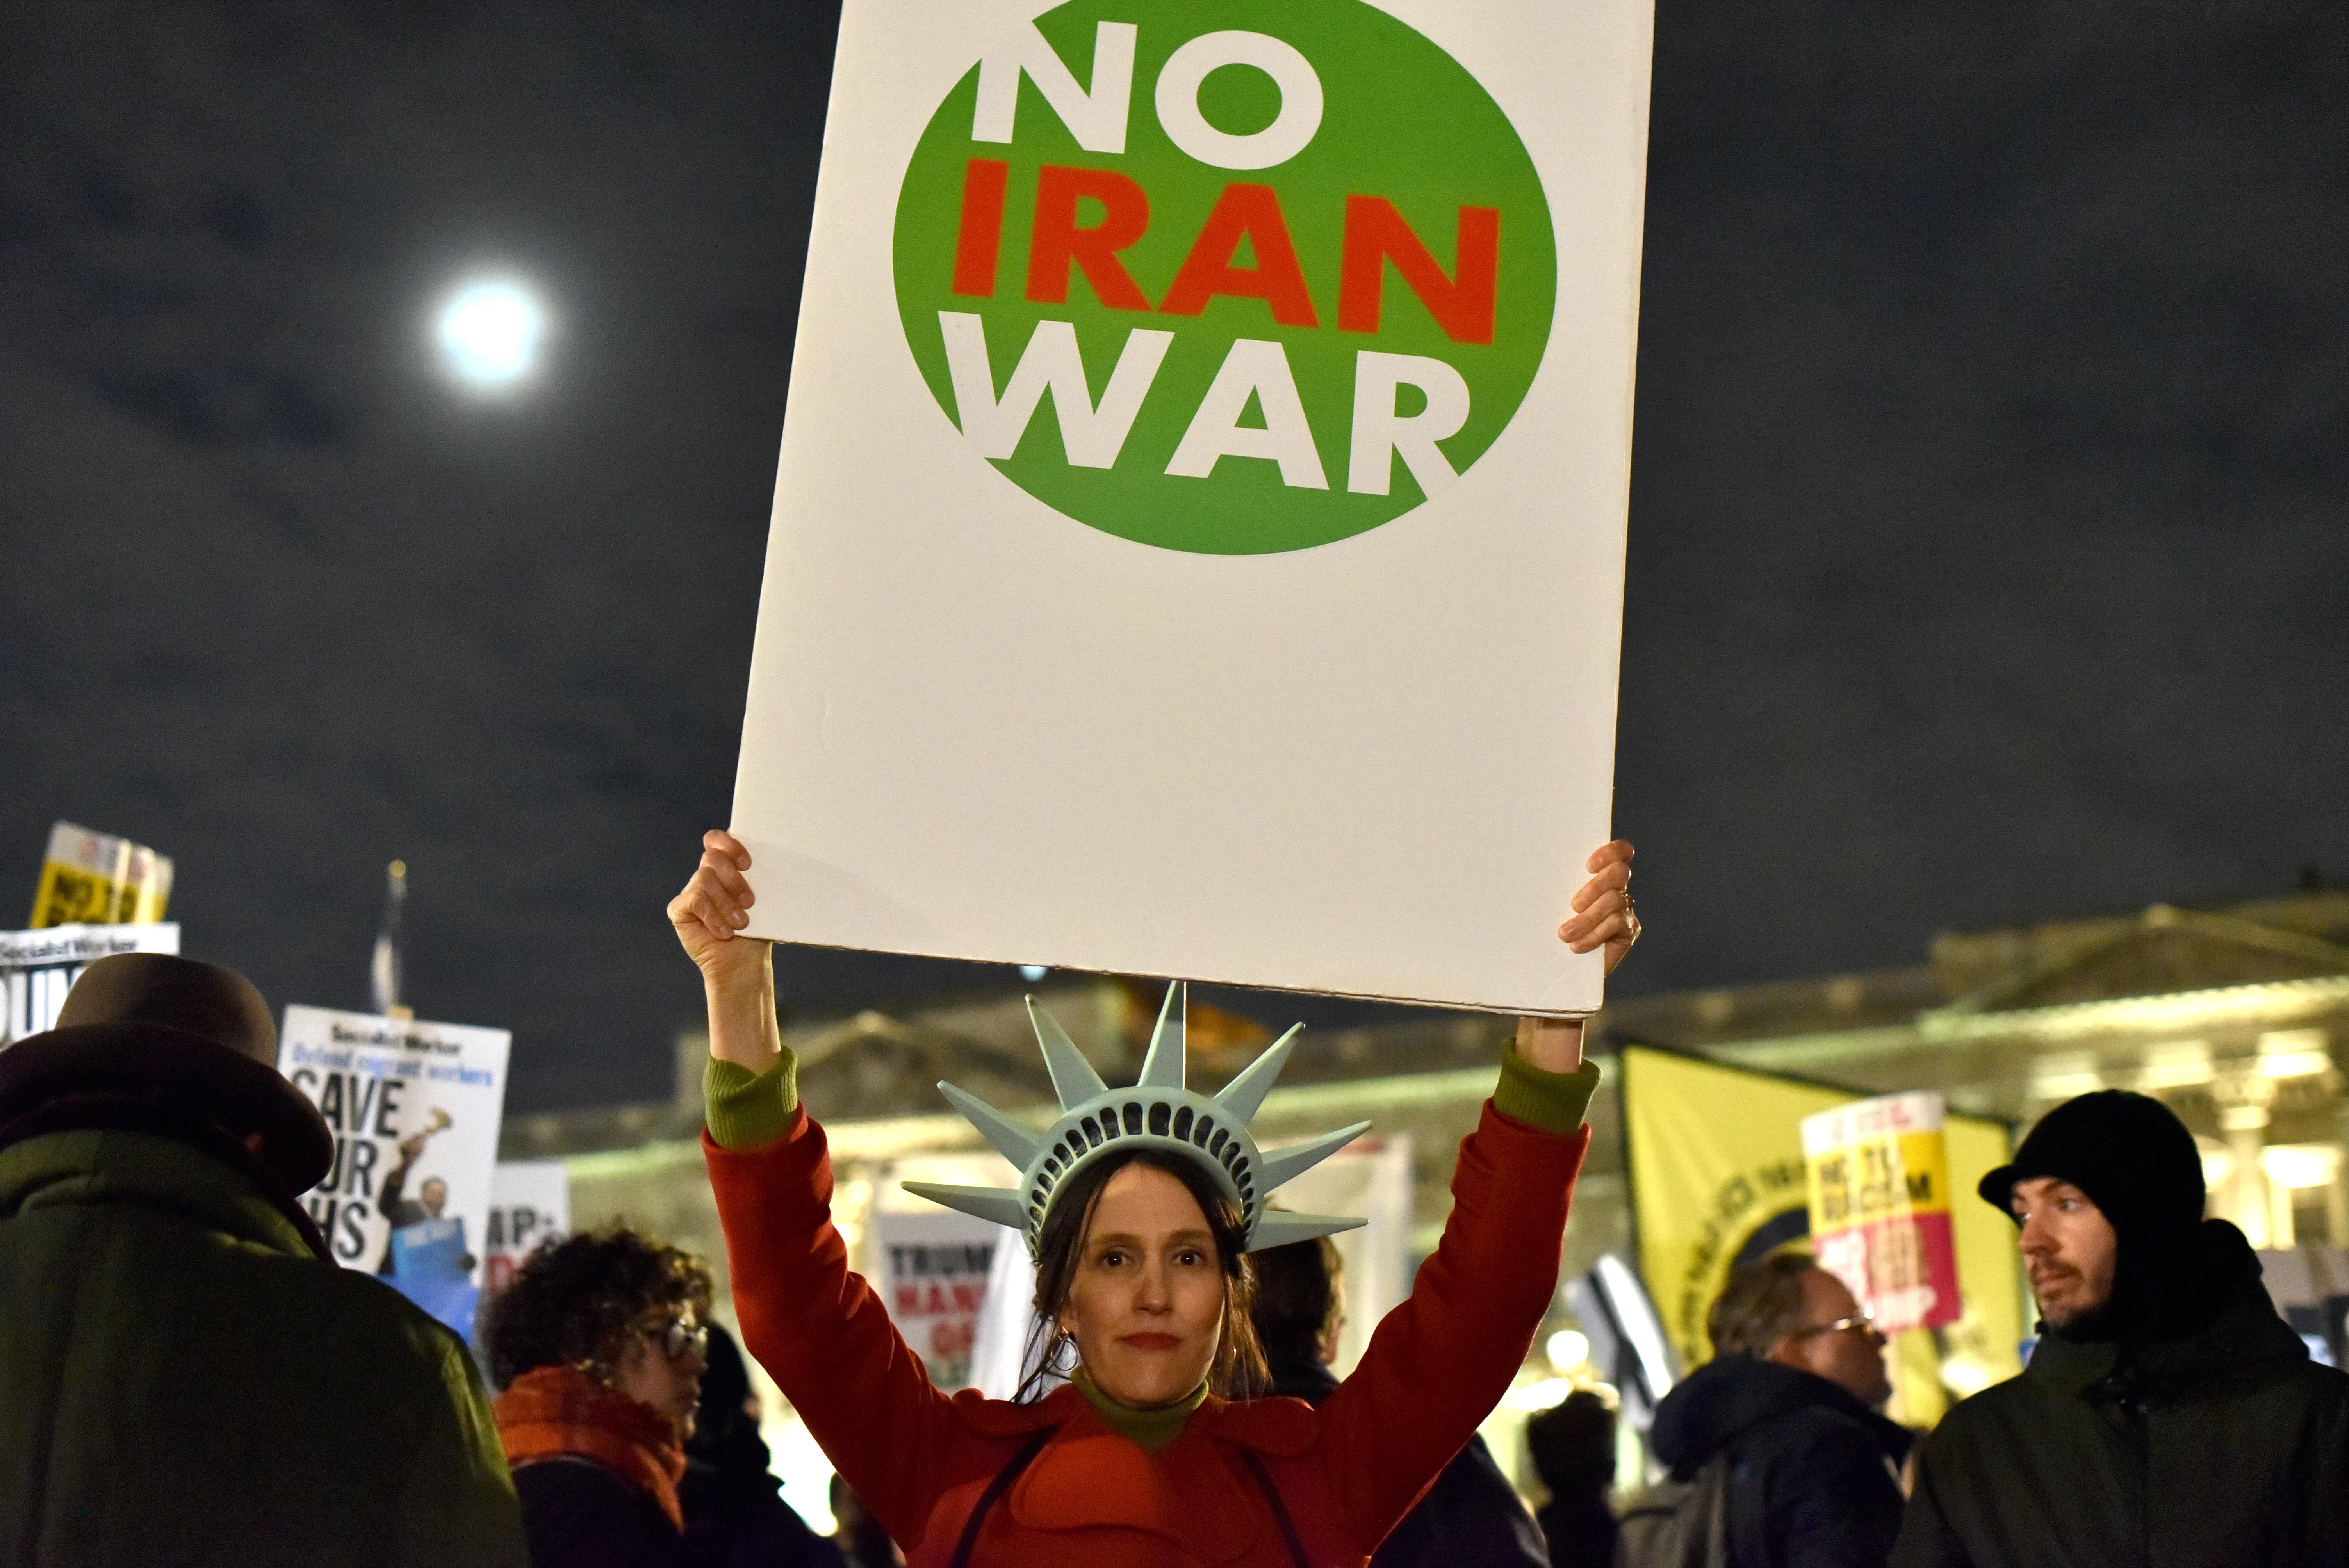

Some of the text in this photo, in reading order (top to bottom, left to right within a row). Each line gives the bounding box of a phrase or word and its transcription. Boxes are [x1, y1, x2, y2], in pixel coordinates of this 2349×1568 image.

[971, 20, 1324, 170] NO
[952, 157, 1501, 346] IRAN
[937, 310, 1471, 500] WAR
